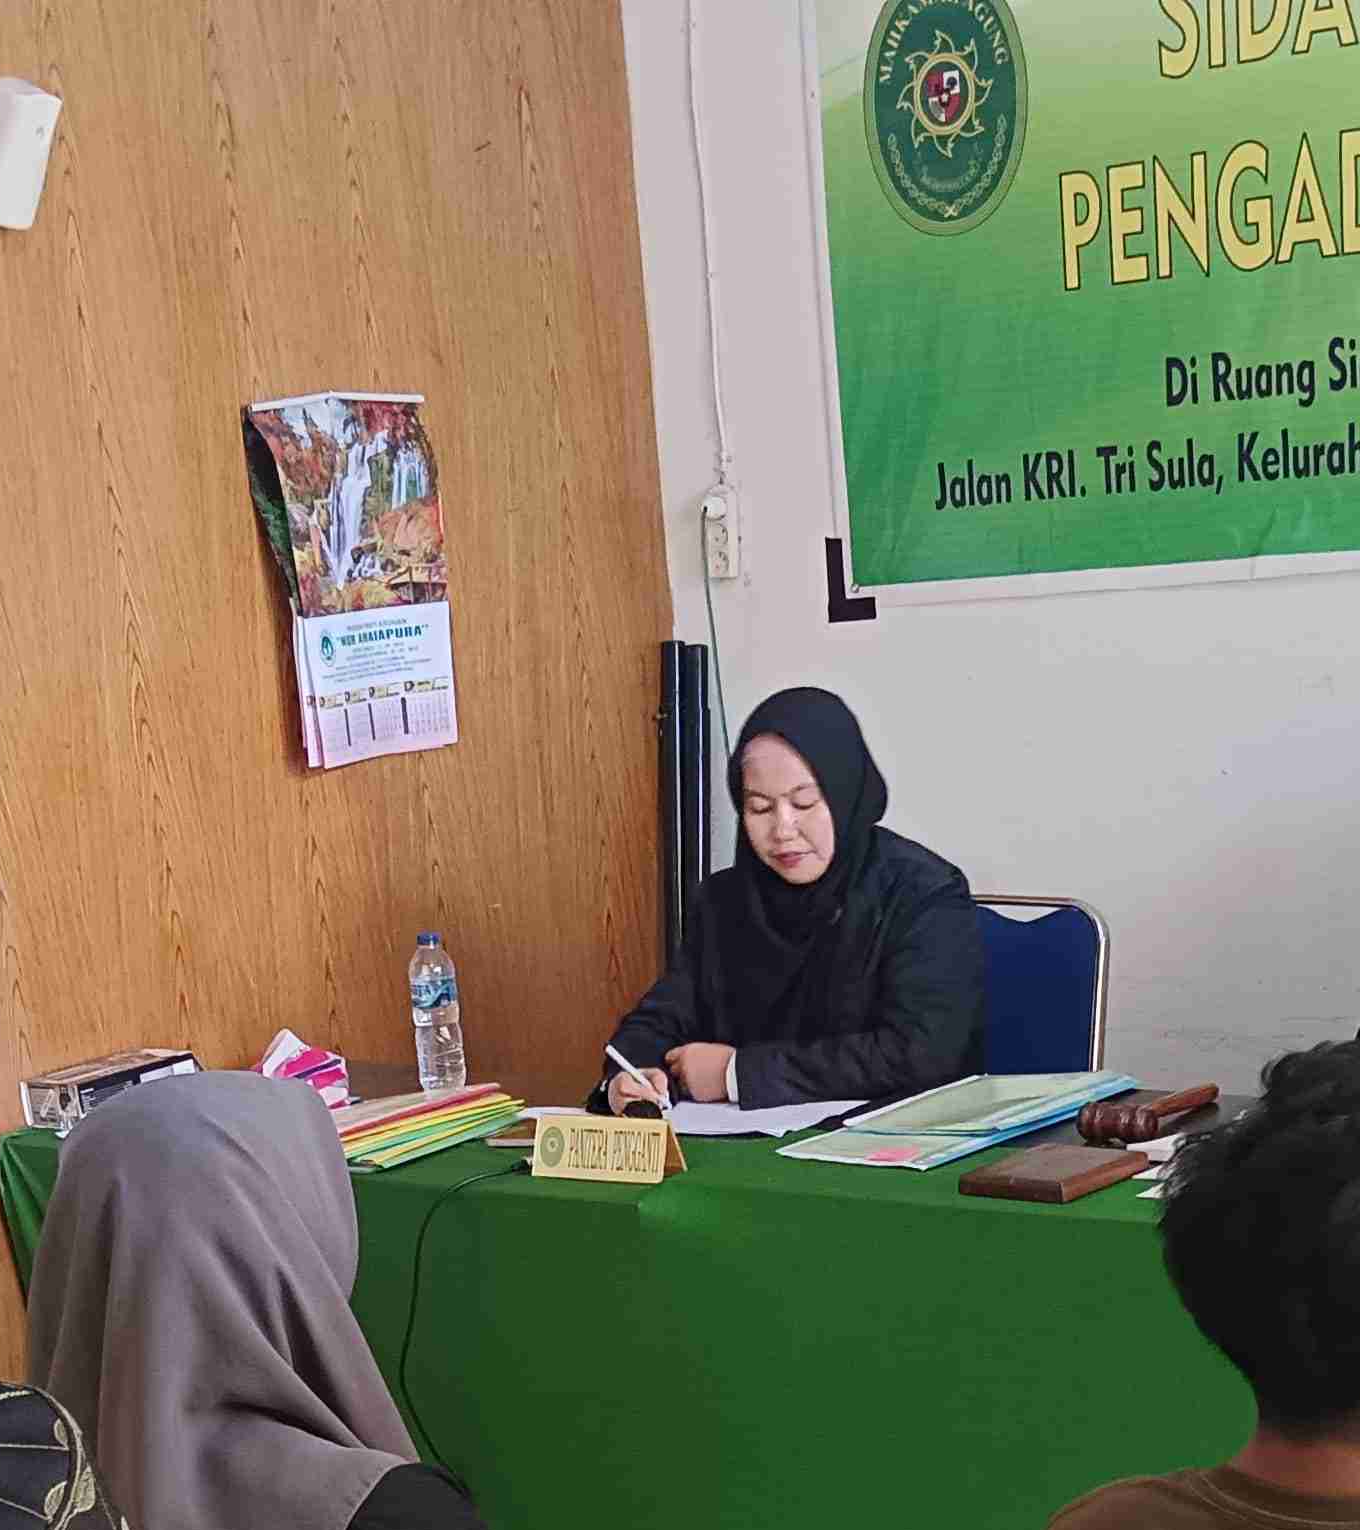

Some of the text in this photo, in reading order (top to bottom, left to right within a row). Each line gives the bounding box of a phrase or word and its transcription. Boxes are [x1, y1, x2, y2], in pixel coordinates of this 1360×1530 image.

[1165, 354, 1199, 408] Di
[1210, 351, 1316, 409] Ruang
[934, 458, 1012, 511] Jalan
[1022, 449, 1086, 502] KRI.
[1095, 444, 1136, 495] Tri
[1146, 437, 1224, 496] Sula,
